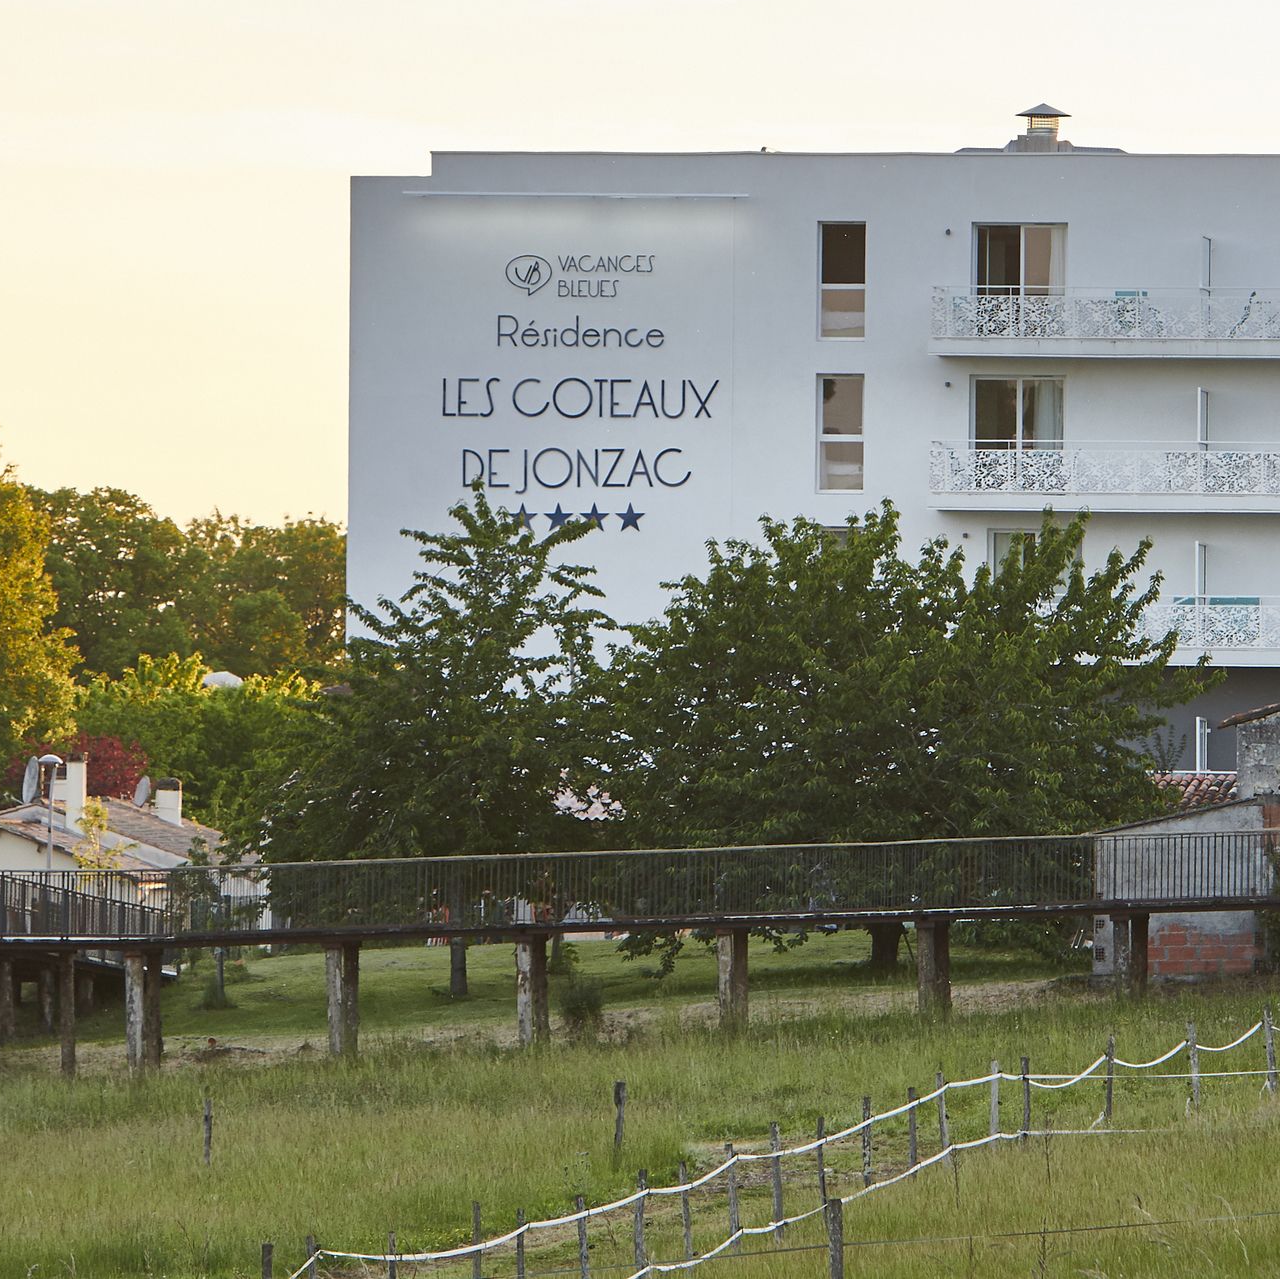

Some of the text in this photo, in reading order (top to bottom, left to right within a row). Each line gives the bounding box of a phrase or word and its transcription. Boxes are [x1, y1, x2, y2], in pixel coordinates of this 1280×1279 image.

[557, 254, 656, 273] VACANCES
[557, 279, 620, 298] BLEUES
[497, 315, 665, 348] Résidence
[442, 377, 720, 419] LES COTEAUX
